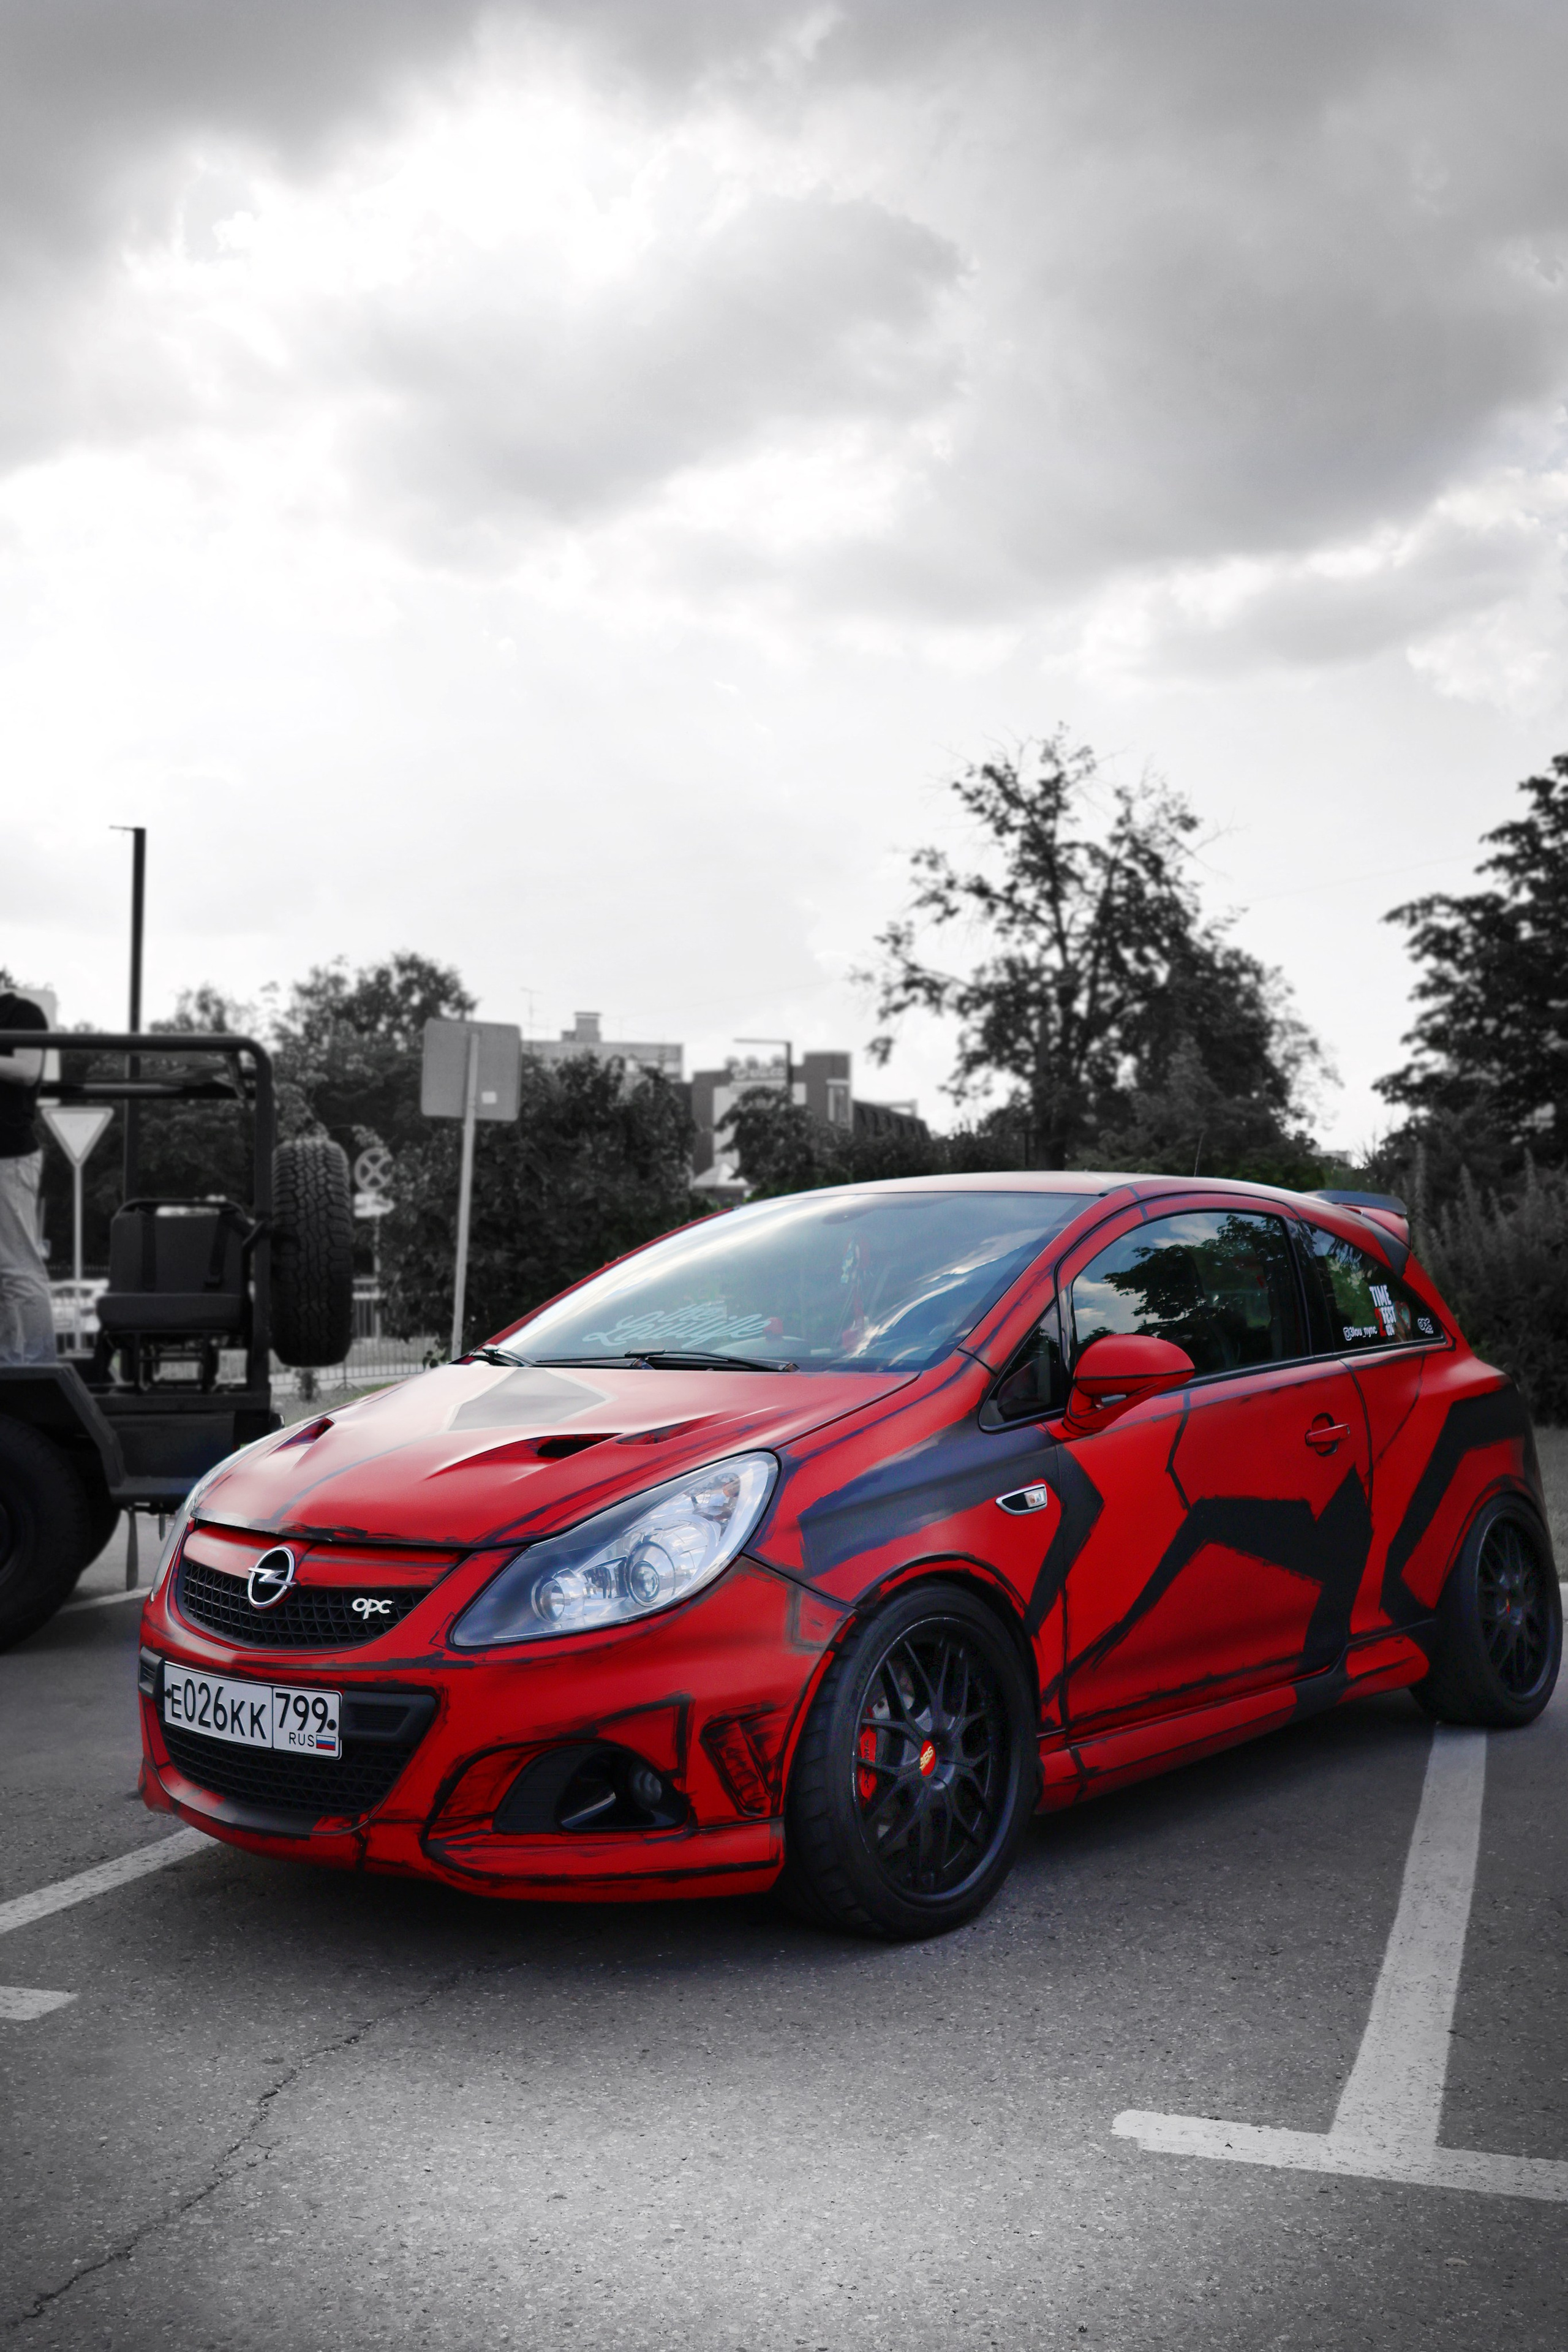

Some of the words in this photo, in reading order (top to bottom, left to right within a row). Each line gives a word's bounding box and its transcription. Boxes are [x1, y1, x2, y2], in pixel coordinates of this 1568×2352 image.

[1369, 1284, 1392, 1306] TIME
[1381, 1305, 1396, 1324] FEST
[275, 1692, 329, 1733] 799
[288, 1733, 315, 1748] RUS
[919, 1746, 933, 1771] BBS
